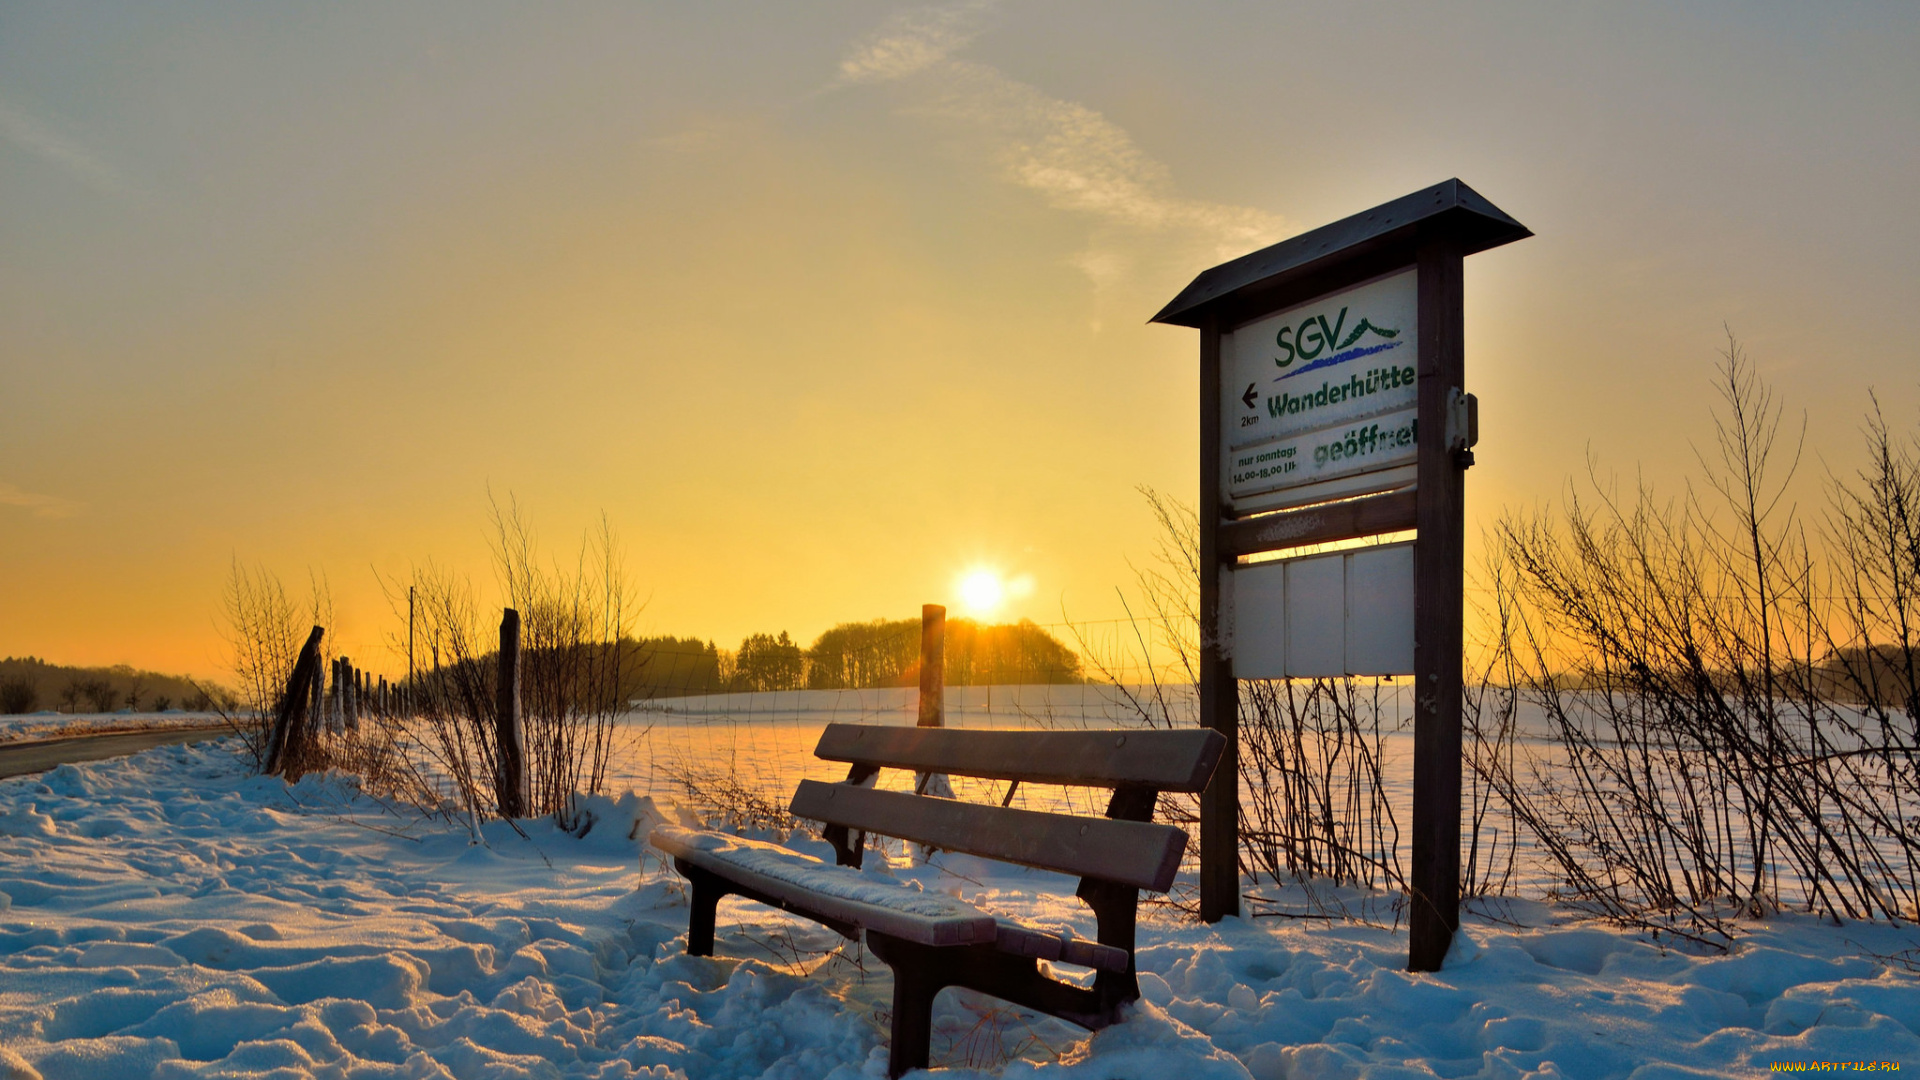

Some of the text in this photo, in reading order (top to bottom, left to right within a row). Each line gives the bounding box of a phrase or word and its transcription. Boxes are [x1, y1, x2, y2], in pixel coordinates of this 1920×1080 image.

[1275, 306, 1348, 368] SGV
[1267, 366, 1415, 419] Wanderhütte
[1241, 415, 1259, 428] 2km
[1238, 446, 1297, 467] nur sonntags
[1233, 465, 1282, 484] 14.00-18.00
